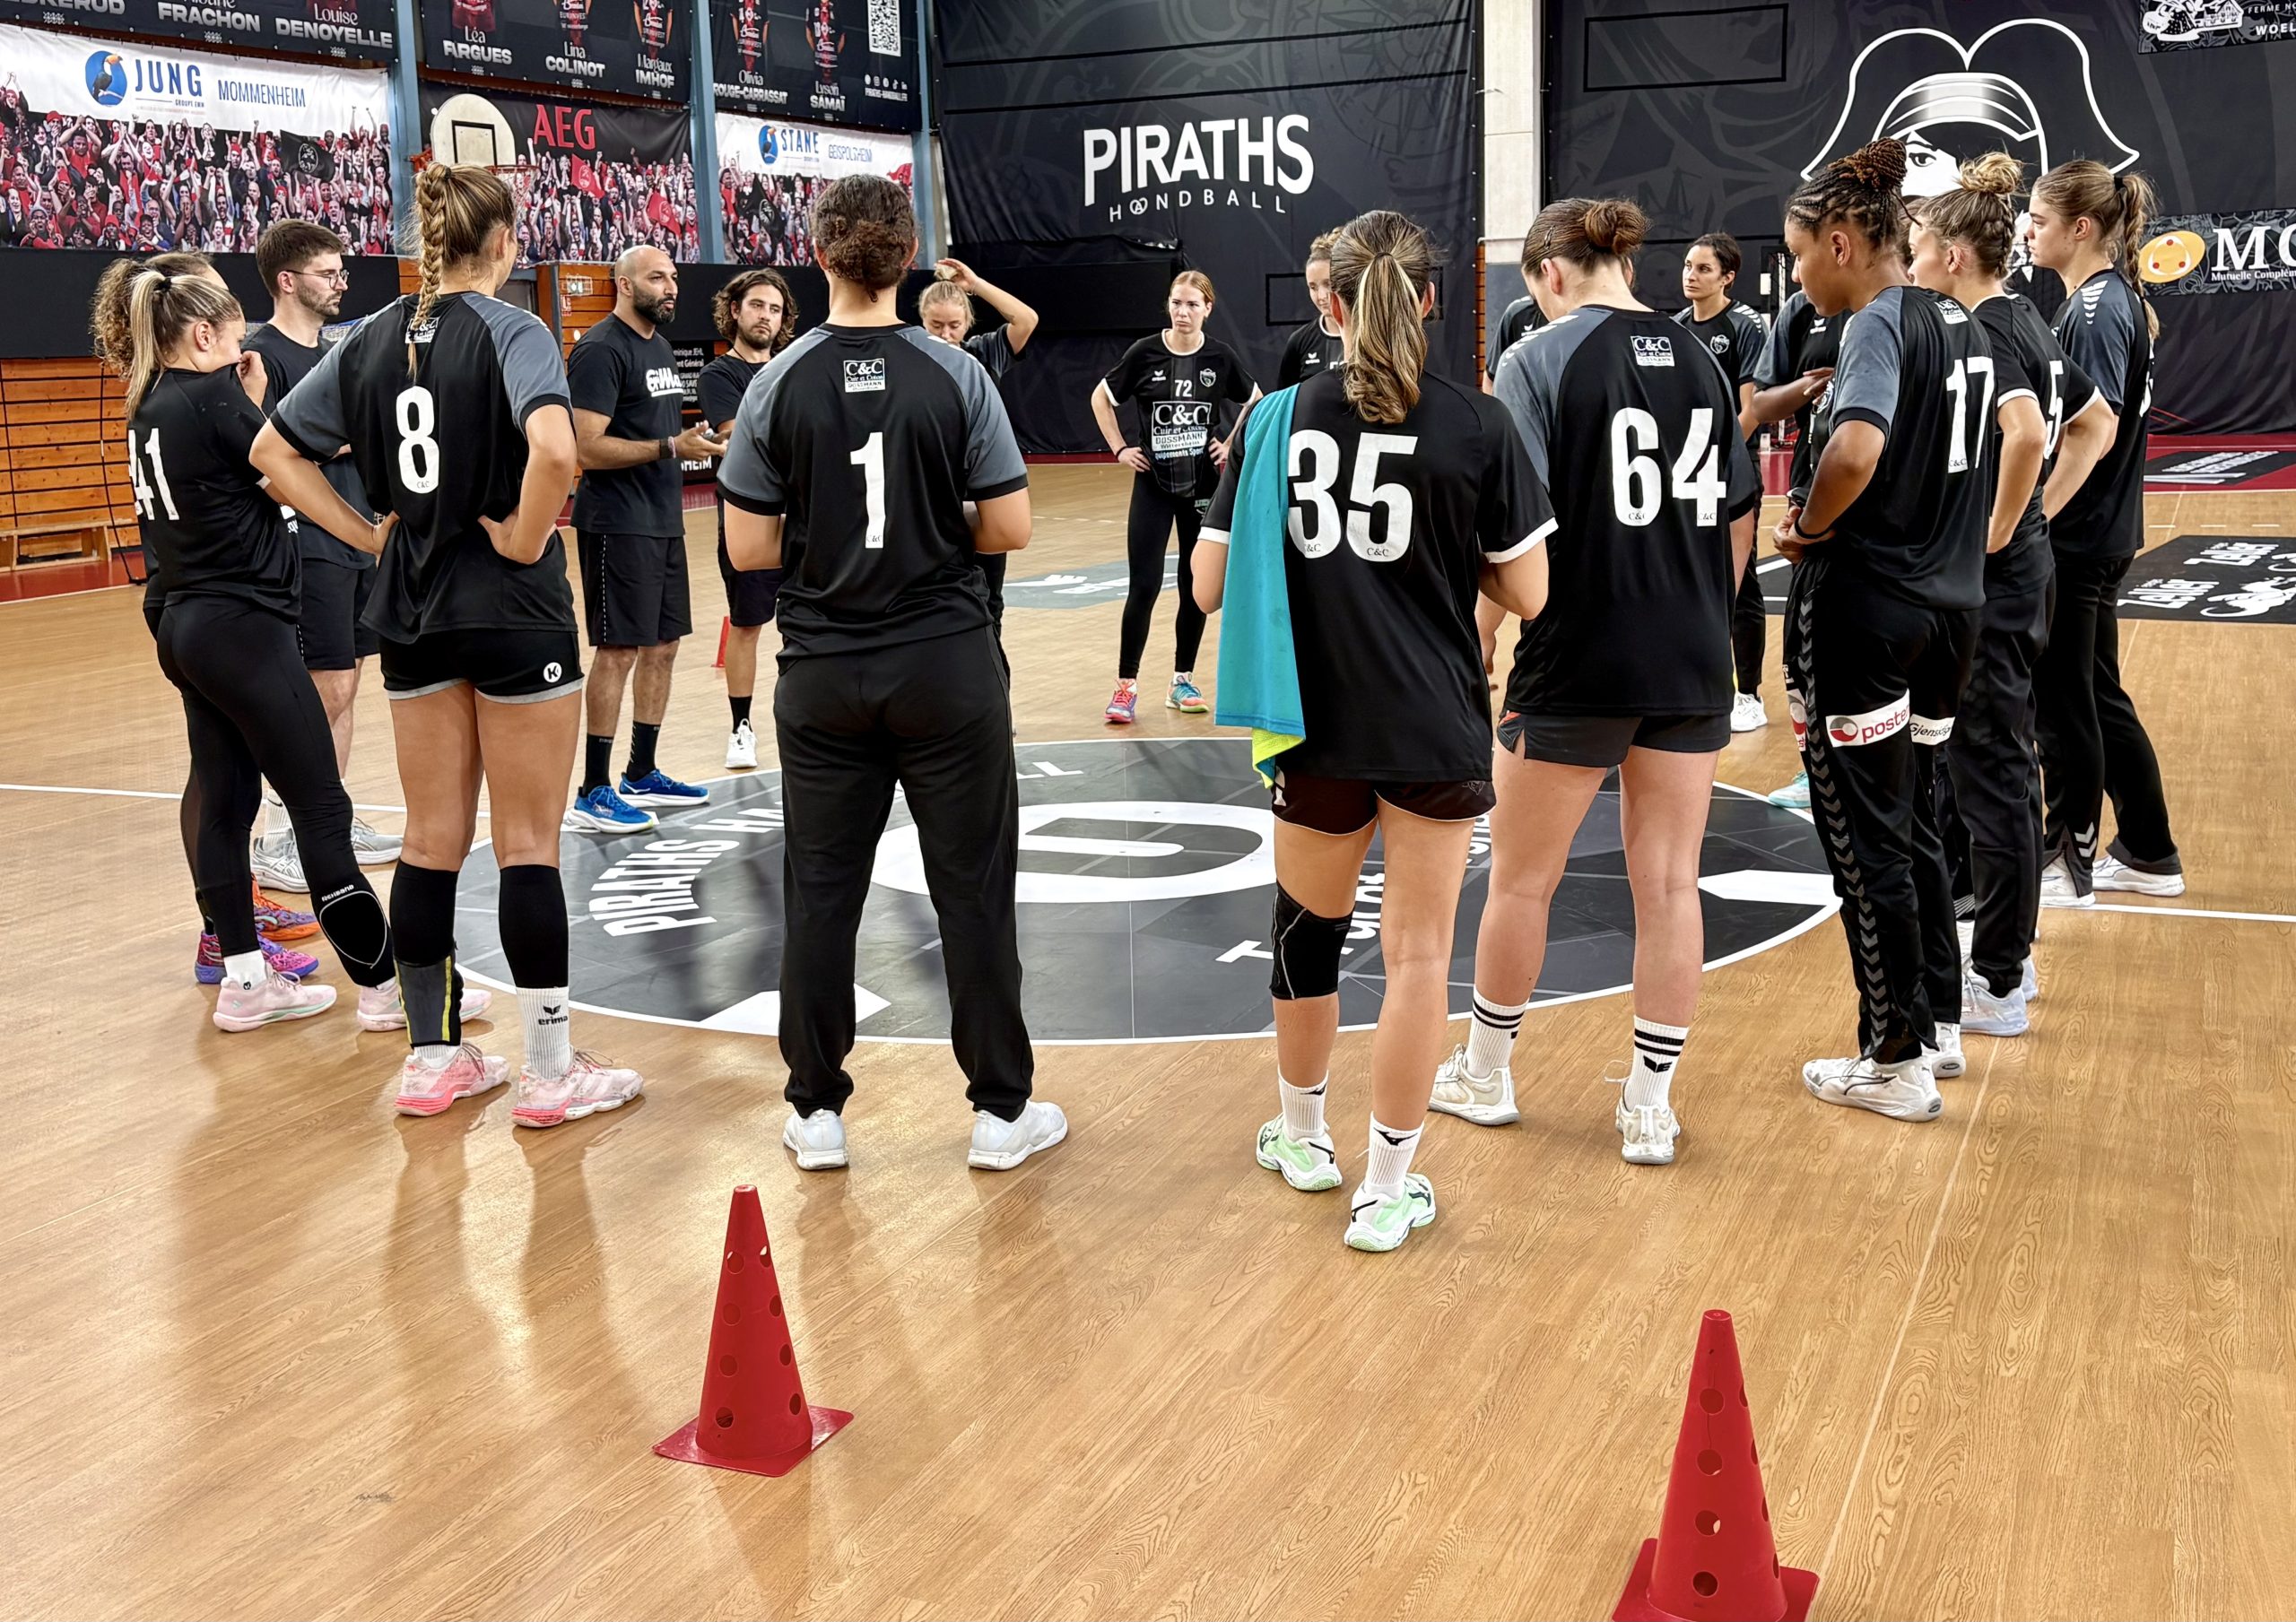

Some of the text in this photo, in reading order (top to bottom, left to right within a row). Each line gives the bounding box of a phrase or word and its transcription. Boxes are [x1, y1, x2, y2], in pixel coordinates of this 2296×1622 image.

[158, 2, 261, 32] FRACHON
[314, 4, 358, 25] Louise
[2248, 4, 2280, 13] FERME
[275, 18, 393, 48] DENOYELLE
[465, 25, 486, 44] Léa
[443, 39, 512, 65] FARGUES
[564, 41, 586, 59] Lina
[545, 56, 605, 78] COLINOT
[135, 59, 306, 108] JUNG MOMMENHEIM
[635, 70, 674, 89] IMHOF
[739, 70, 763, 86] Olivia
[534, 104, 596, 151] AEG
[1083, 114, 1314, 206] PIRATHS
[1109, 188, 1286, 222] HANDBALL
[2212, 272, 2252, 282] Mutuelle
[1634, 337, 1670, 351] C&C
[846, 360, 883, 376] C&C
[1174, 379, 1193, 397] 72
[1154, 403, 1209, 426] C&C
[1945, 356, 1995, 473] 17
[396, 386, 439, 494] 8
[1153, 426, 1172, 436] Cuir
[1155, 432, 1204, 445] DOSSMANN
[681, 455, 712, 472] HEIM
[1611, 407, 1726, 527] 64
[416, 481, 430, 489] C&C
[850, 431, 886, 549] 1
[1287, 429, 1418, 562] 35
[1367, 546, 1389, 558] C&C
[588, 839, 740, 937] PIRATHS
[538, 1016, 569, 1026] erima
